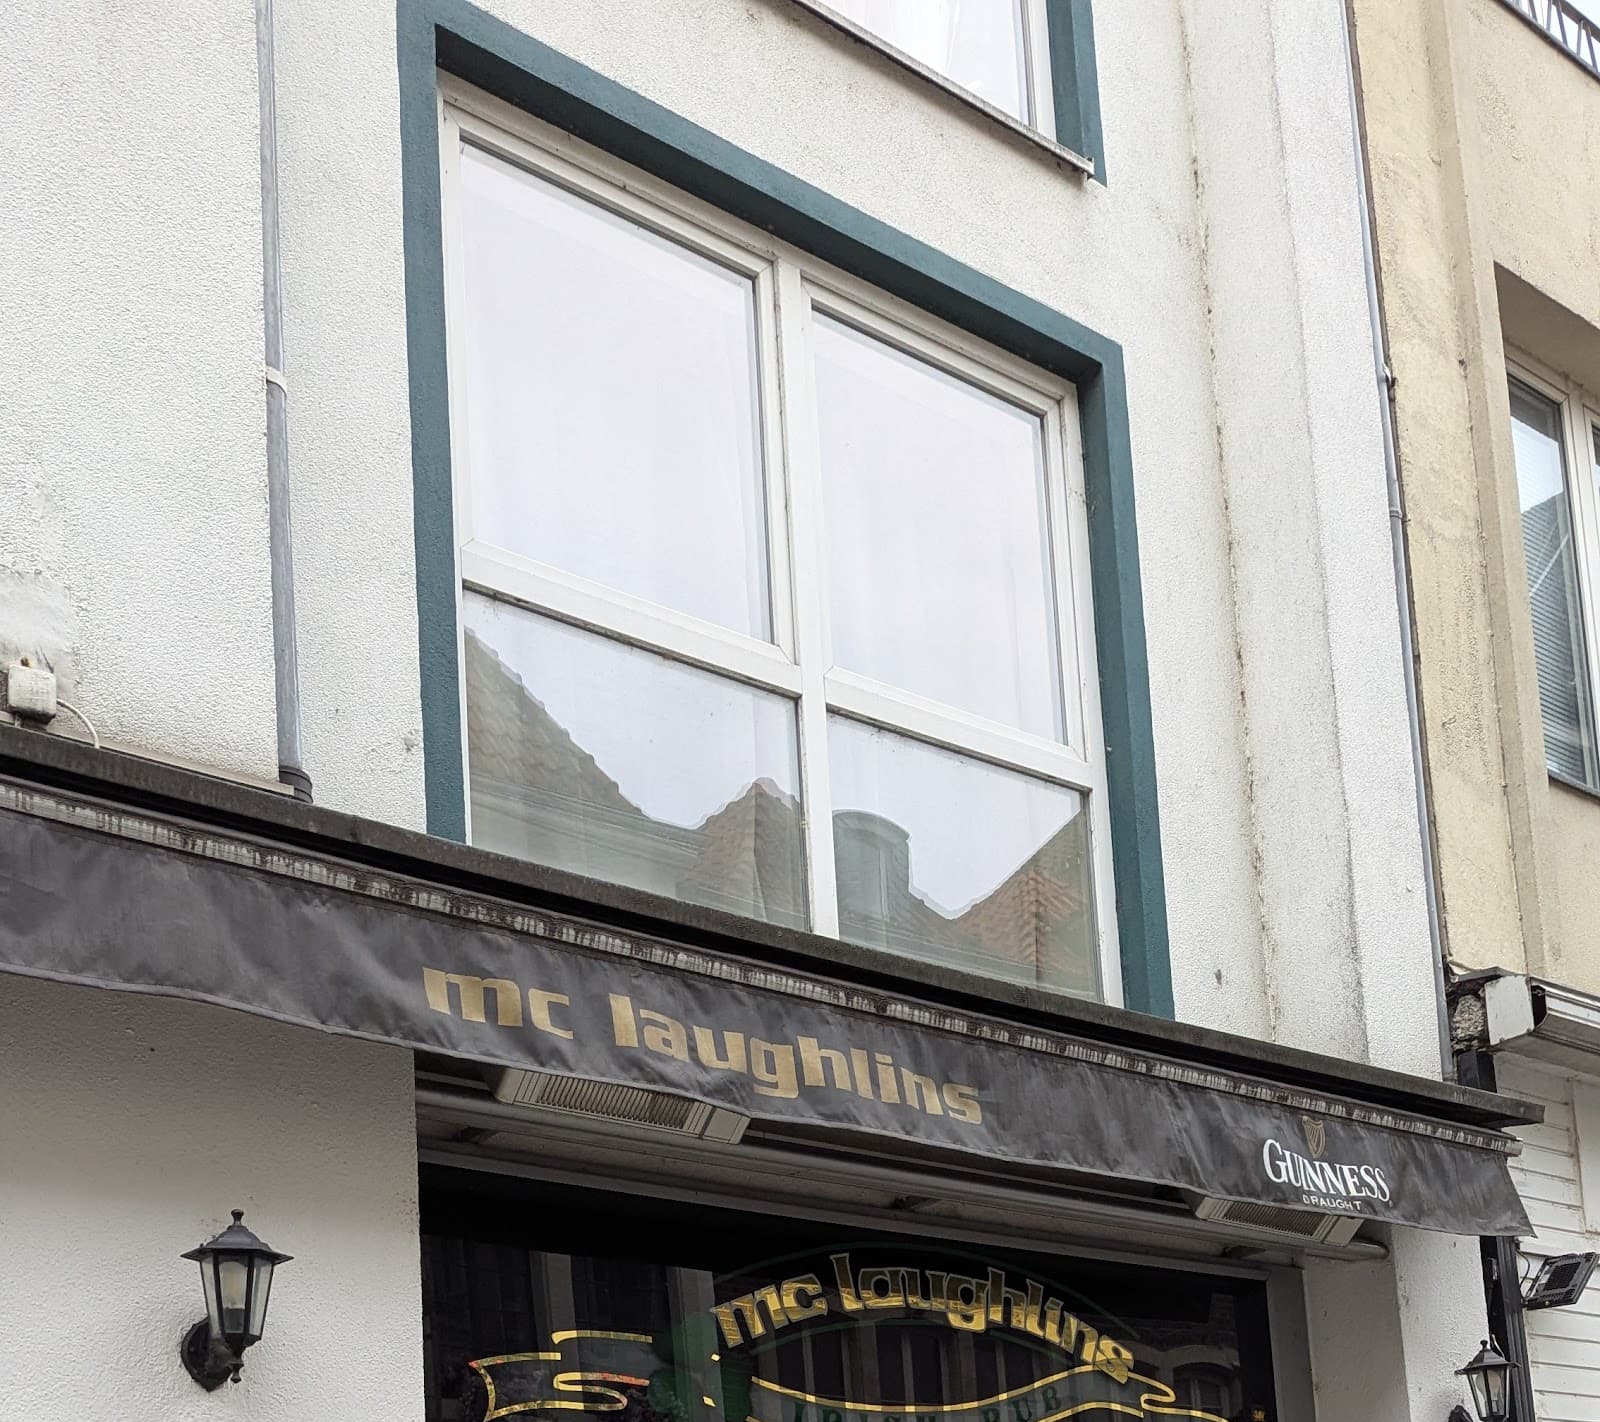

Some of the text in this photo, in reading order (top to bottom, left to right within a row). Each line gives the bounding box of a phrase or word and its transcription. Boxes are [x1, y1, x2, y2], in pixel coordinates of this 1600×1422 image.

[423, 967, 983, 1125] mc laughlins
[1263, 1138, 1391, 1202] GUINNESS
[1303, 1194, 1362, 1211] DRAUGHT
[710, 1253, 1135, 1384] mc laughlins
